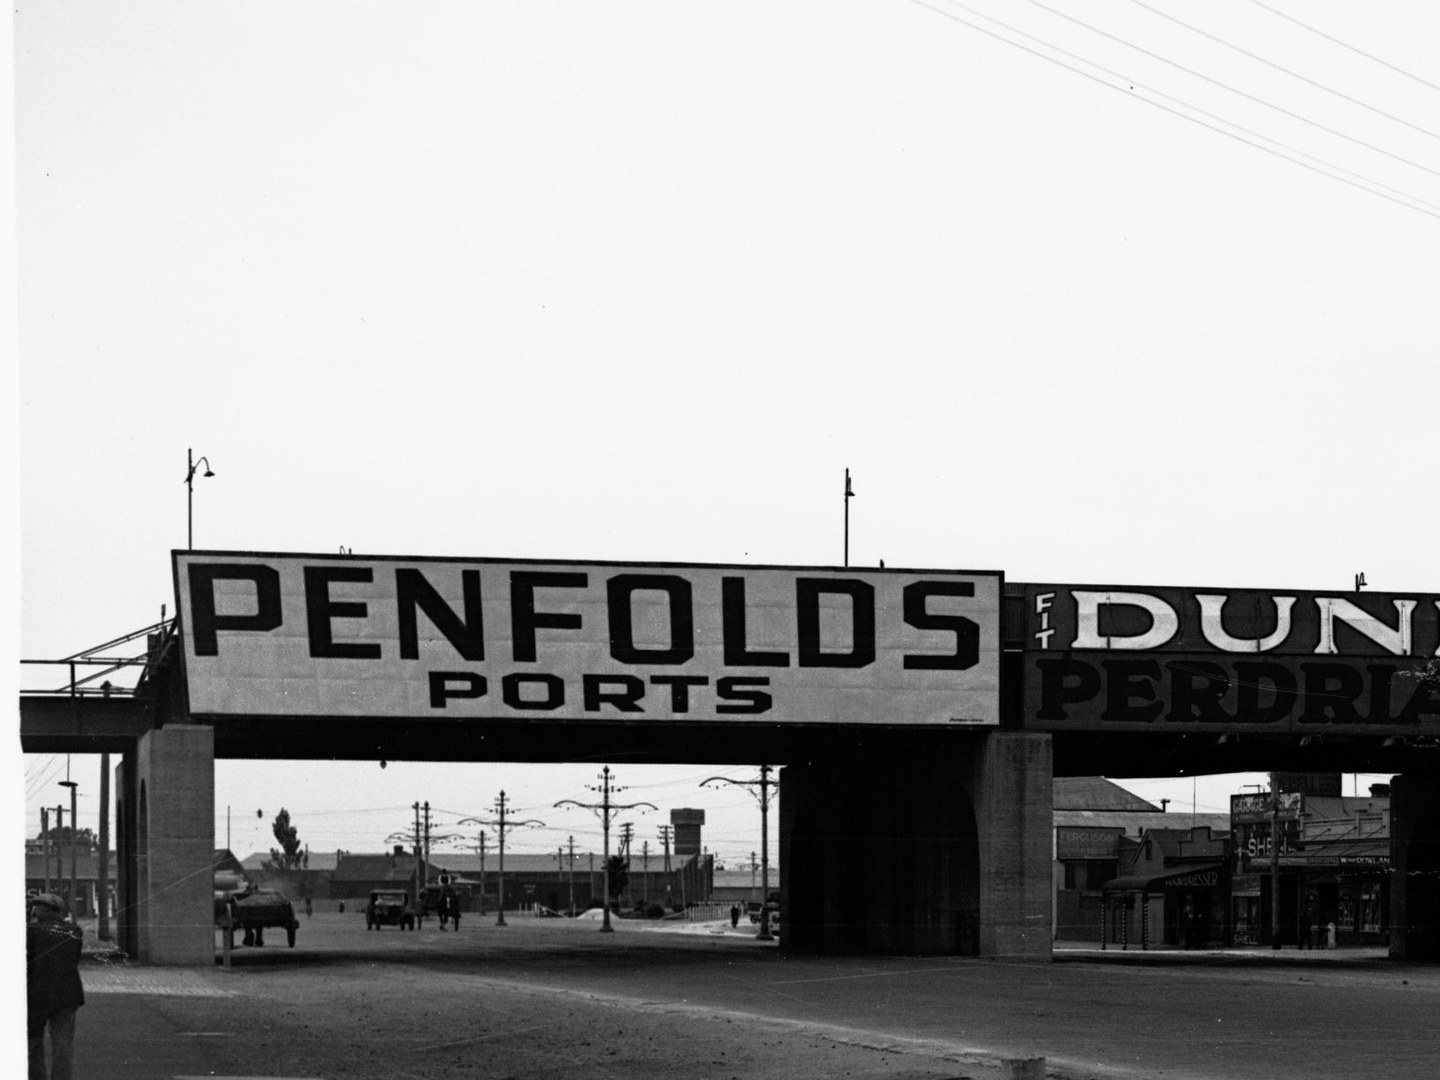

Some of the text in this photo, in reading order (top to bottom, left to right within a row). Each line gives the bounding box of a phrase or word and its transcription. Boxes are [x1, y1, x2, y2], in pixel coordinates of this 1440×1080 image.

[188, 563, 980, 670] PENFOLDS
[1035, 592, 1056, 650] FIT
[428, 671, 774, 715] PORTS
[1165, 871, 1218, 887] HAIRDRESSER
[1233, 934, 1258, 945] SHELL
